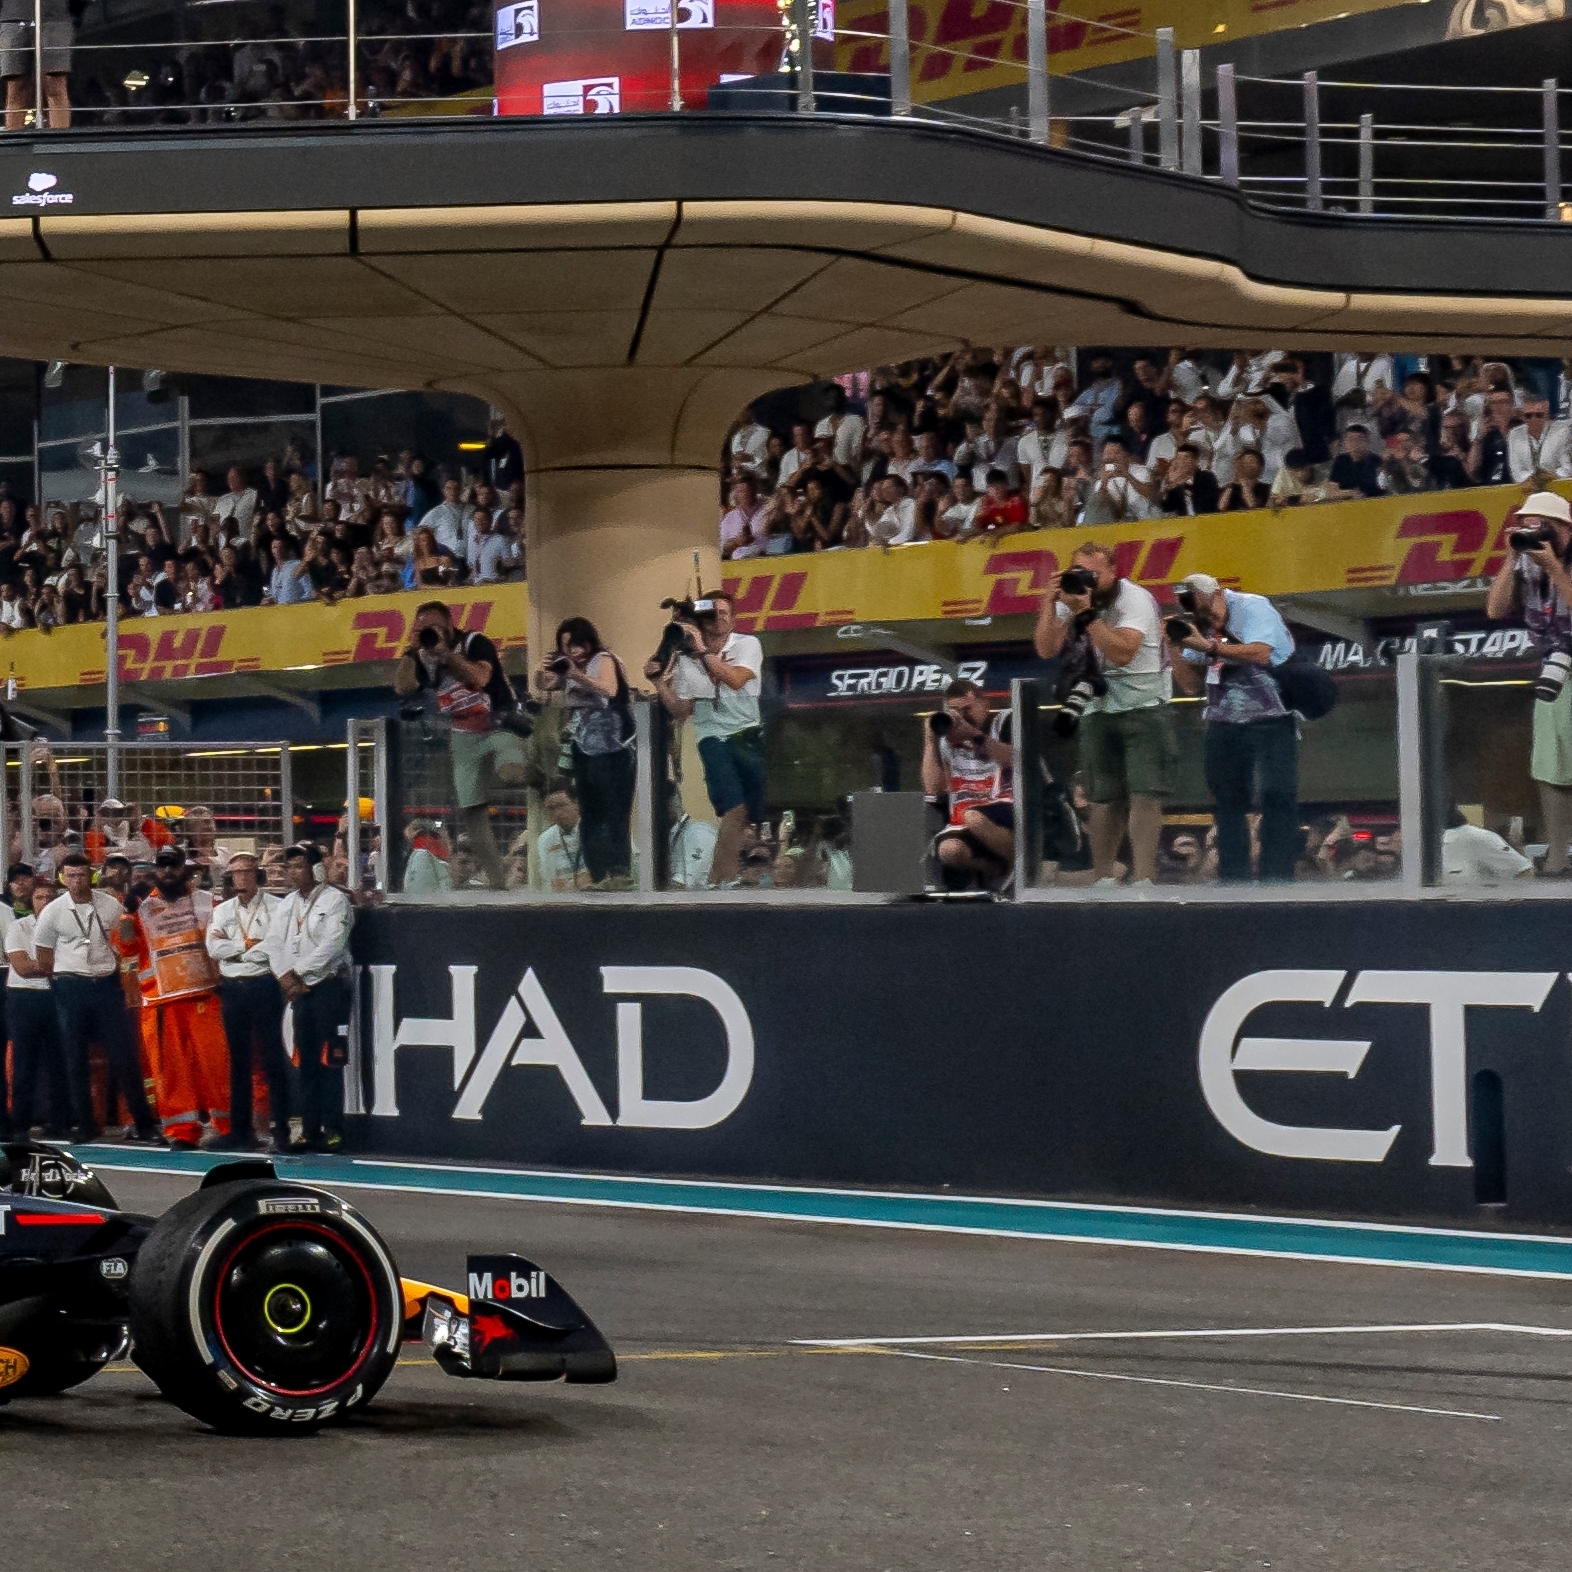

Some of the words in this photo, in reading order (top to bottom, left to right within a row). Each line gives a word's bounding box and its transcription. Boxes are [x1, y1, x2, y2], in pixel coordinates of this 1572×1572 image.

[11, 192, 74, 207] salesforce
[113, 625, 234, 682] DHL
[342, 964, 756, 1130] IHAD
[1198, 968, 1572, 1167] ET
[468, 1271, 547, 1300] Mobil
[242, 1395, 340, 1423] ZERO
